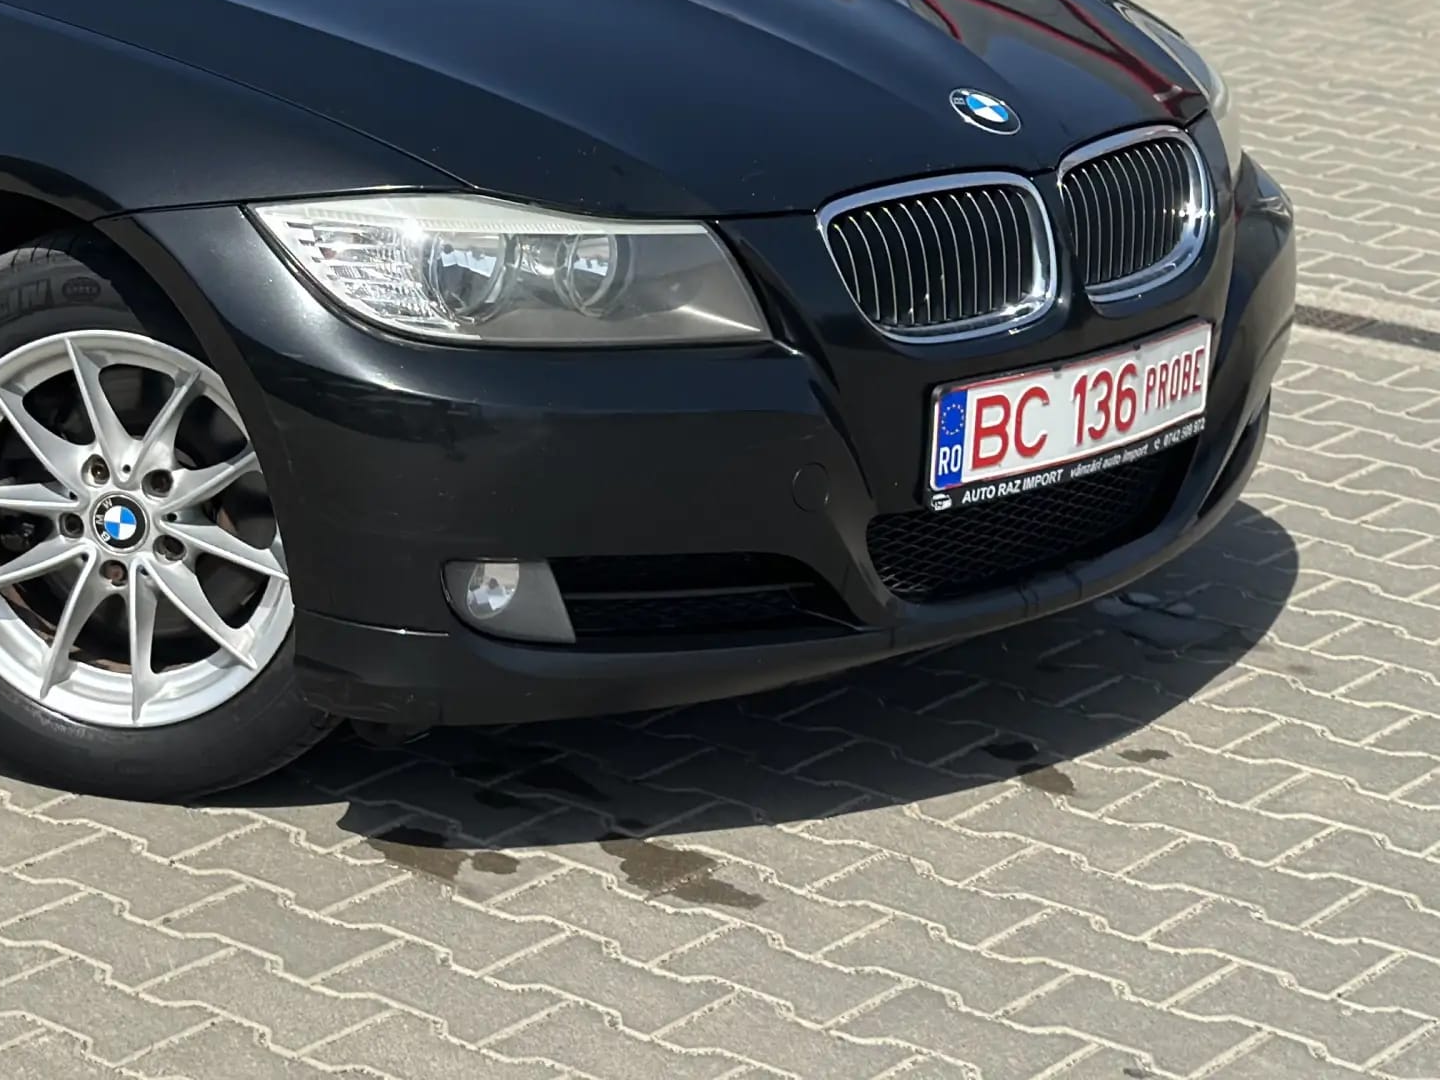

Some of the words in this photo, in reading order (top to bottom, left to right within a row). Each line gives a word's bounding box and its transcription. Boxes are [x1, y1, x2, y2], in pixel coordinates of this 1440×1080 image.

[972, 386, 1050, 470] BC
[1072, 363, 1138, 446] 136
[1142, 347, 1205, 413] PROBE
[938, 444, 961, 476] RO
[962, 484, 996, 504] AUTO
[997, 479, 1021, 496] RAZ
[1022, 469, 1064, 491] IMPORT
[1102, 453, 1122, 470] auto
